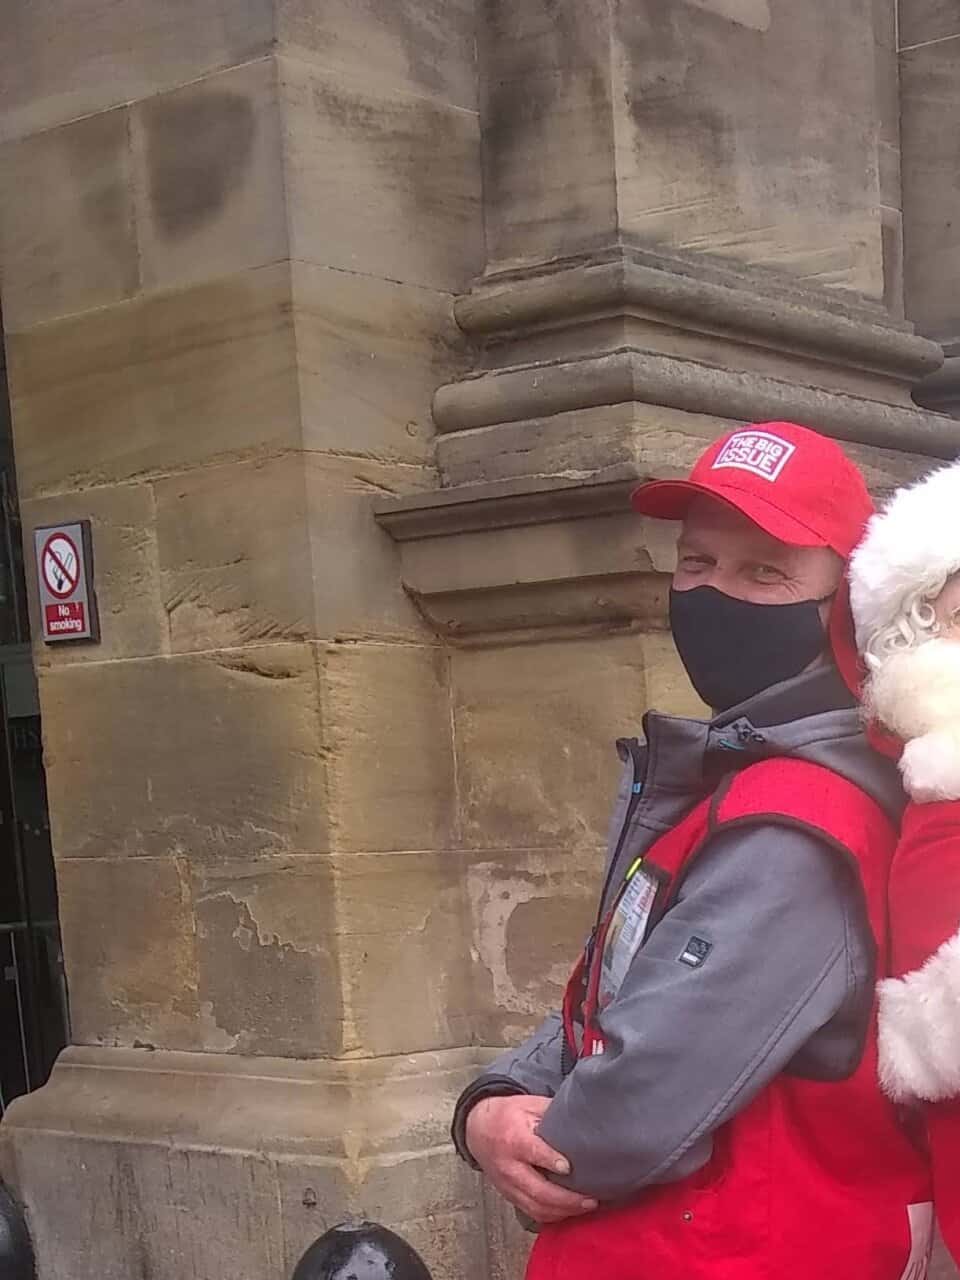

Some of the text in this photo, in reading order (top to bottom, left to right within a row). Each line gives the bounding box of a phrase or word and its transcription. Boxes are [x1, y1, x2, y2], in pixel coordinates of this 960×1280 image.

[731, 436, 784, 458] THE BIG
[719, 447, 778, 474] ISSUE
[58, 604, 70, 617] No
[49, 617, 82, 632] smoking
